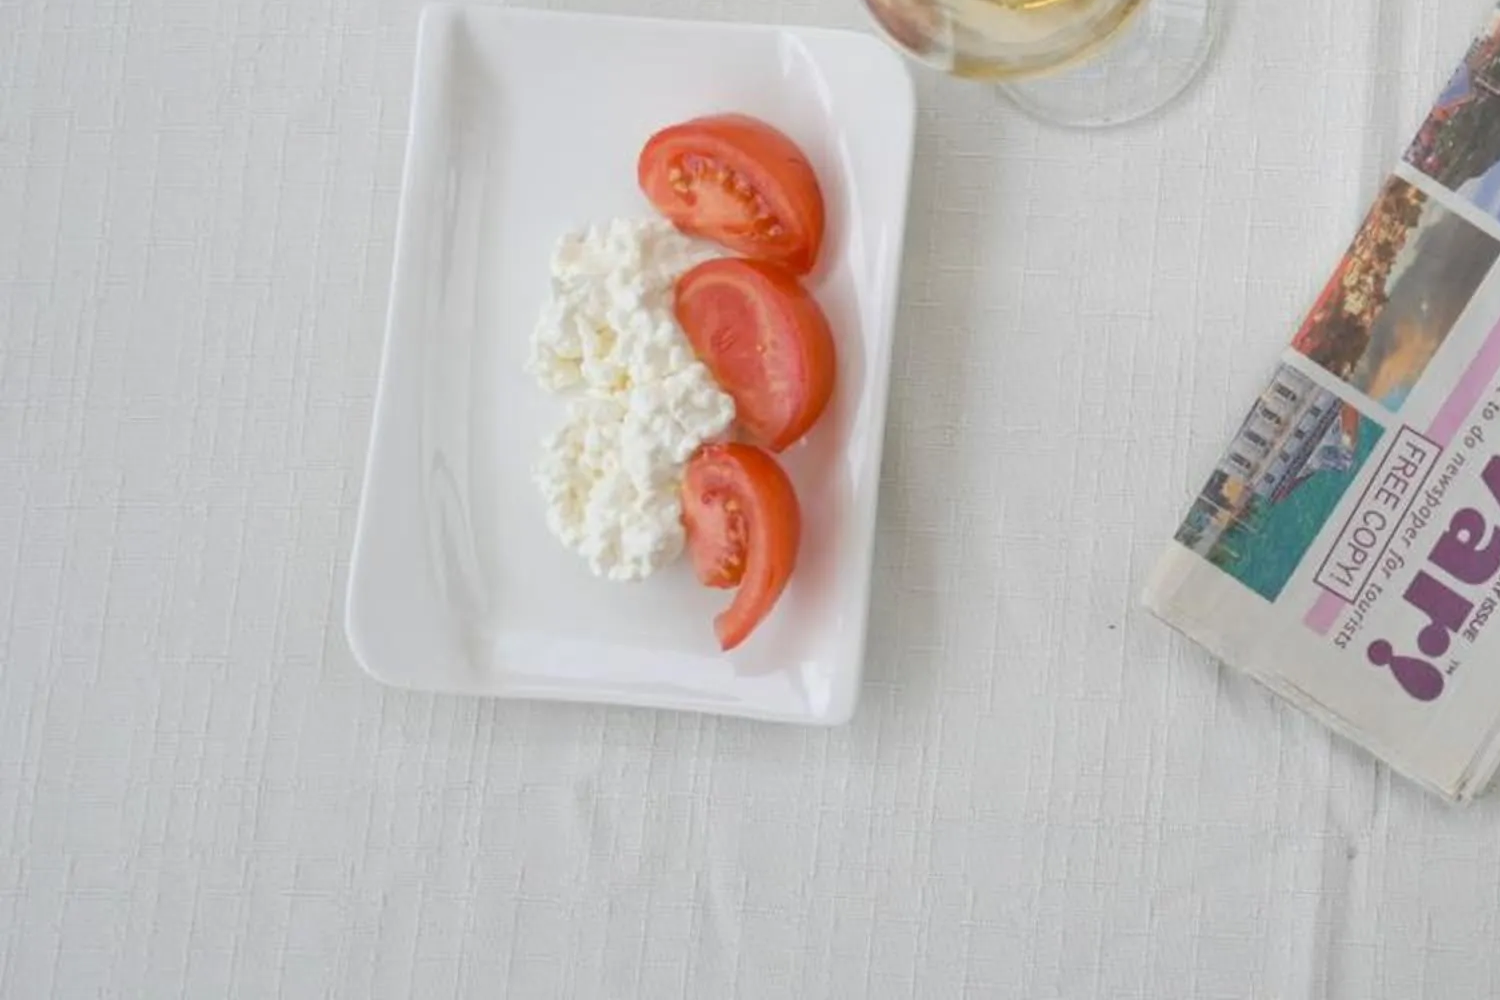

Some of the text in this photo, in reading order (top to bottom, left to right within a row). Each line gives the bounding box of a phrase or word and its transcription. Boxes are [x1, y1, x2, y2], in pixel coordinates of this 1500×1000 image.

[1481, 401, 1500, 421] to
[1463, 424, 1485, 449] do
[1329, 441, 1427, 588] FREE COPY!
[1392, 452, 1466, 549] newspaper
[1380, 547, 1406, 580] for
[1333, 582, 1384, 650] tourists
[1462, 596, 1498, 644] ISSUE
